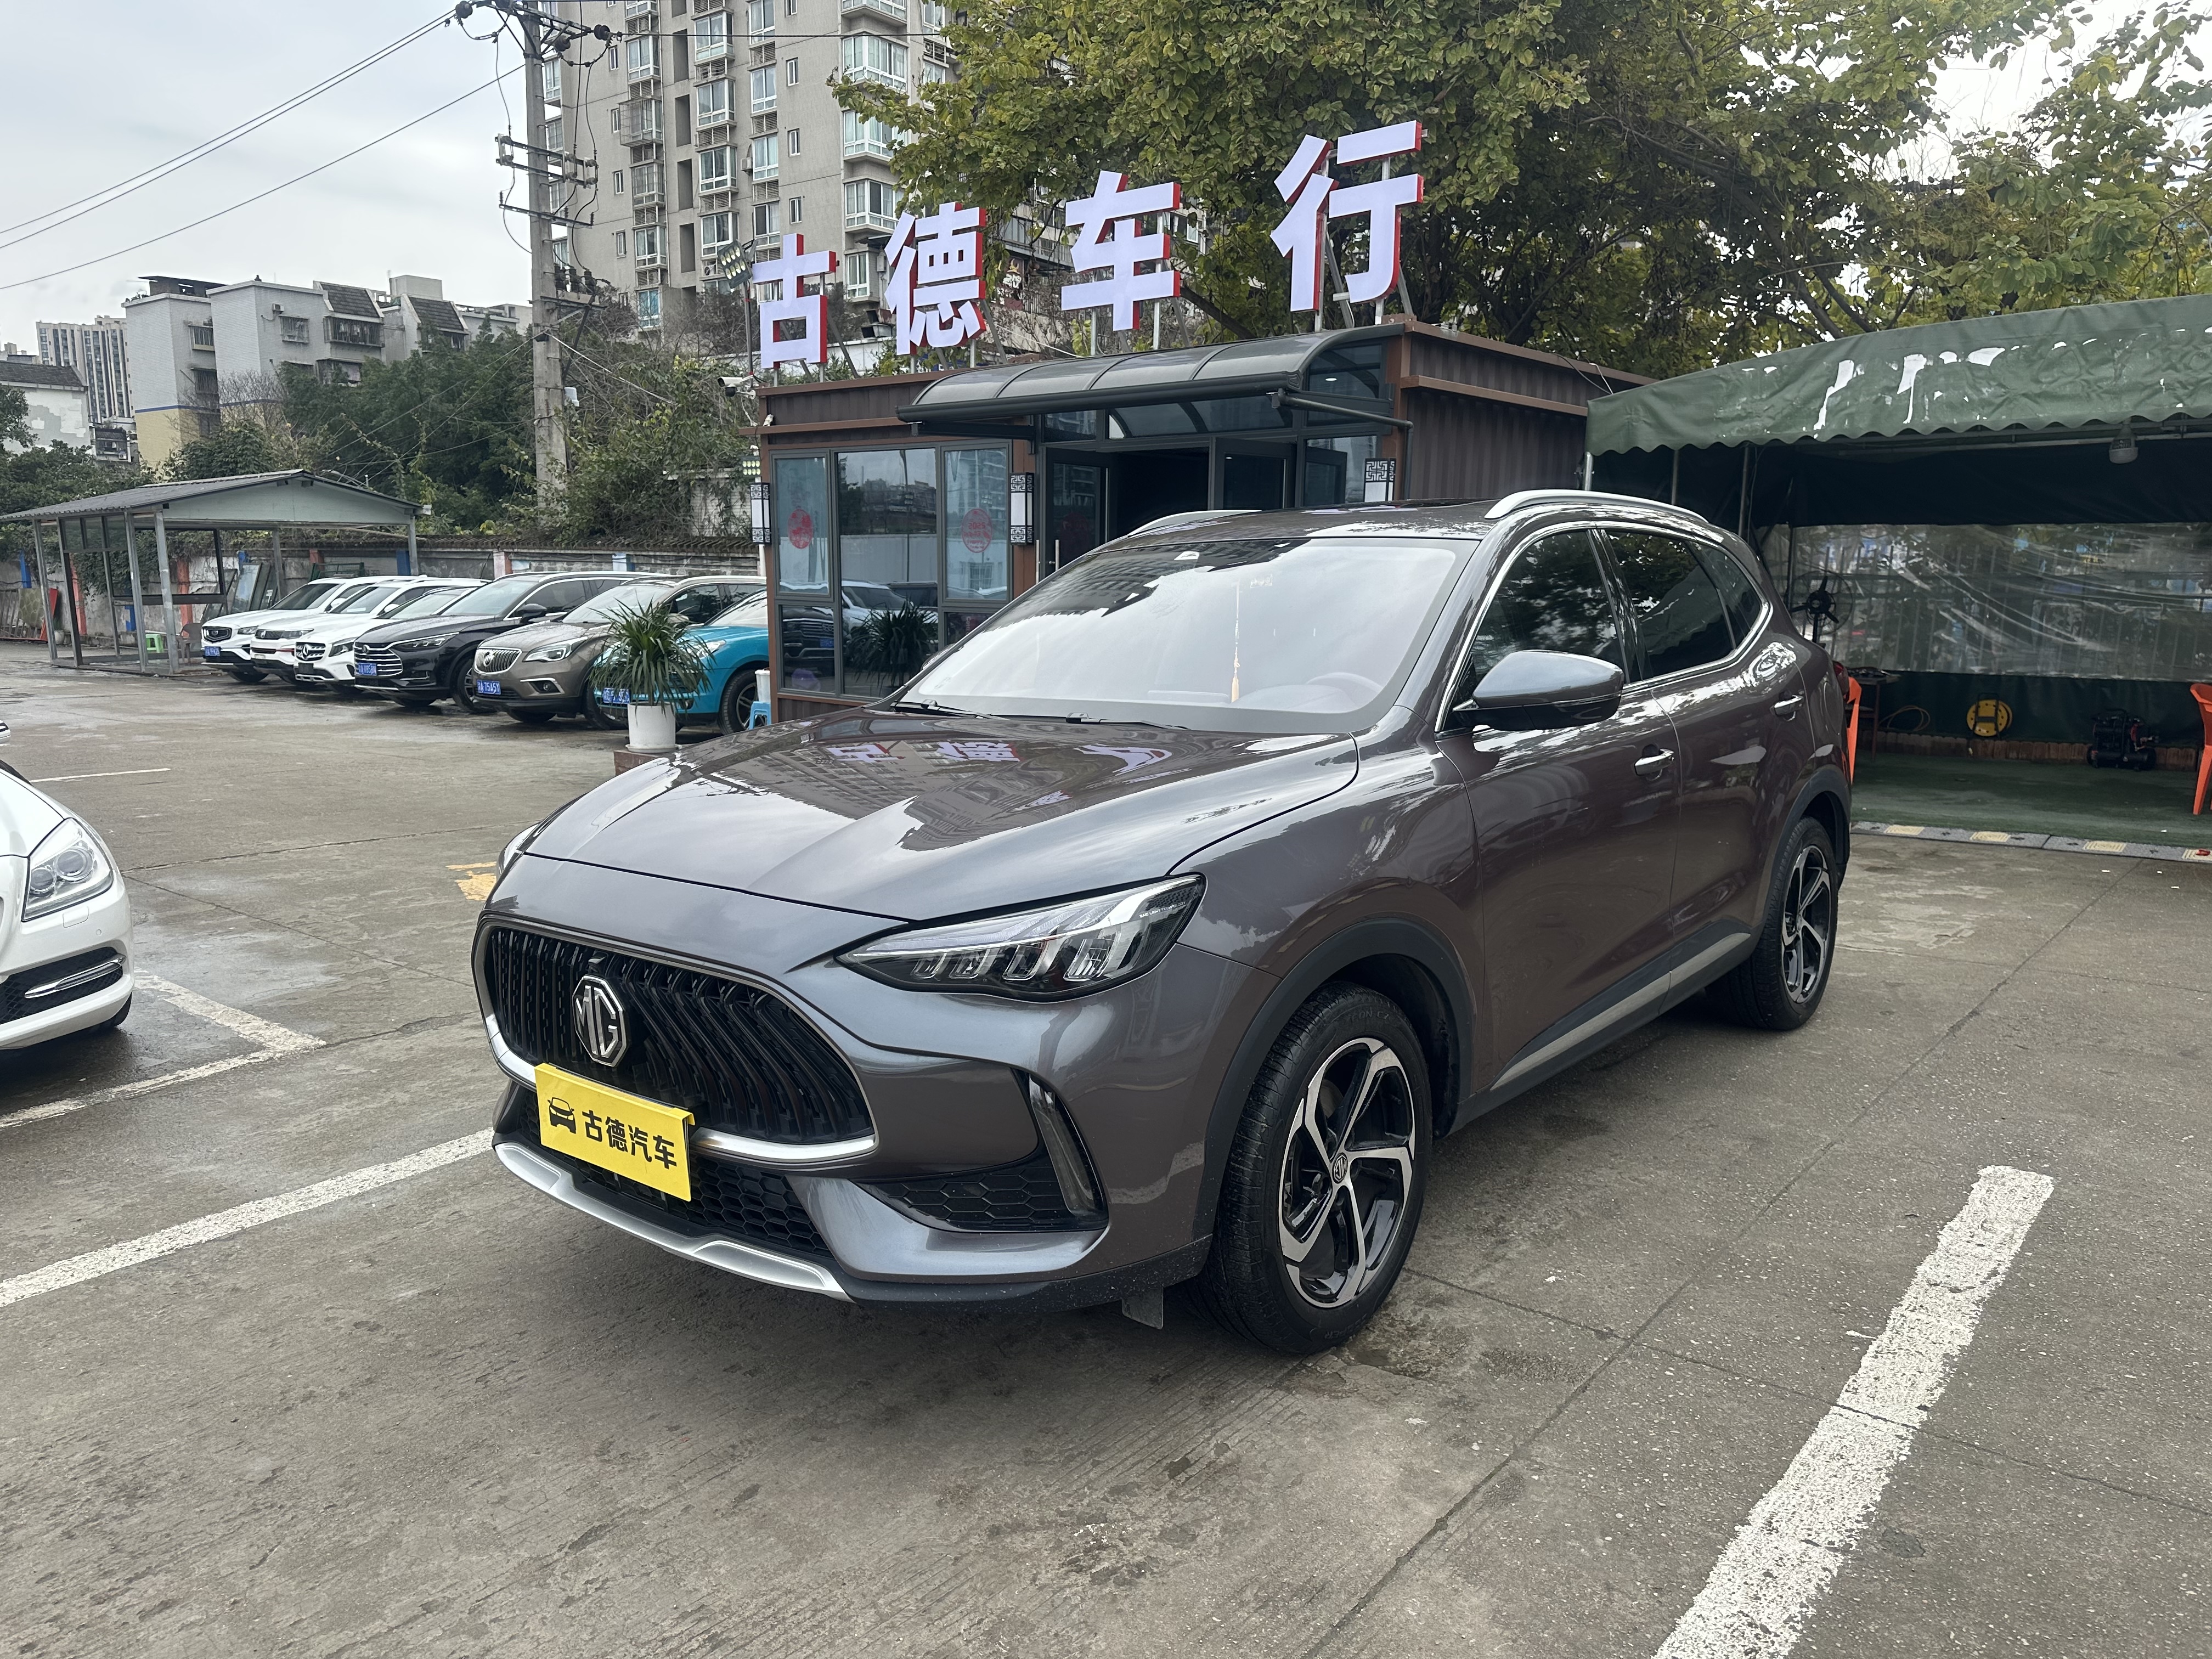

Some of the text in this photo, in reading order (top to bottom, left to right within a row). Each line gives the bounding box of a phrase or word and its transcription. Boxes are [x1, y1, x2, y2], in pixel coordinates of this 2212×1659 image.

[752, 121, 1423, 369] 古德车行
[575, 984, 619, 1059] MG
[582, 1109, 678, 1170] 古德汽车
[1335, 1156, 1346, 1180] MG
